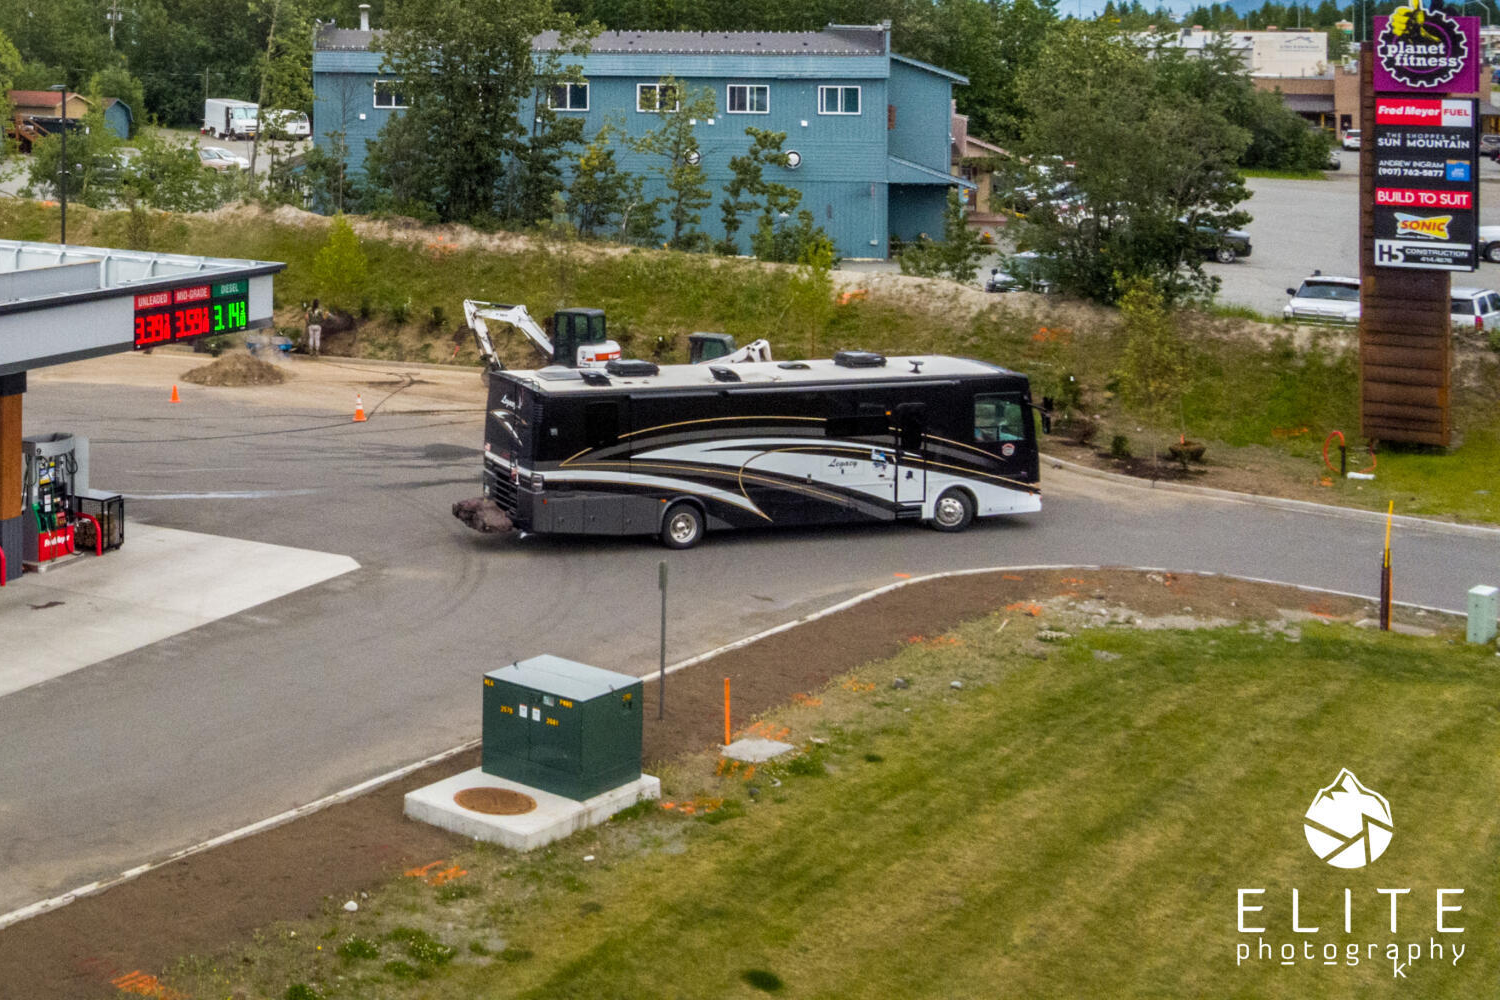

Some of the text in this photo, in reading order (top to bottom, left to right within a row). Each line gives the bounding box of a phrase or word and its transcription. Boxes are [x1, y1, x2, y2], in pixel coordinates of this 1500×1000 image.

[1386, 41, 1446, 57] planet
[1394, 53, 1457, 67] fitness
[1378, 105, 1440, 118] Fred Meyer
[1444, 108, 1470, 117] FUEL
[1377, 138, 1470, 149] SUN MOUNTAIN
[1378, 160, 1445, 169] ANDREW INGRAM
[1378, 167, 1402, 176] (907)
[1377, 190, 1468, 206] BUILD TO SUIT
[1400, 220, 1446, 232] SONIC
[1379, 244, 1469, 263] H5 CONSTRUCTION
[138, 283, 239, 307] UNLEADED MID-GRADE DIESEL
[828, 458, 858, 469] Legacy
